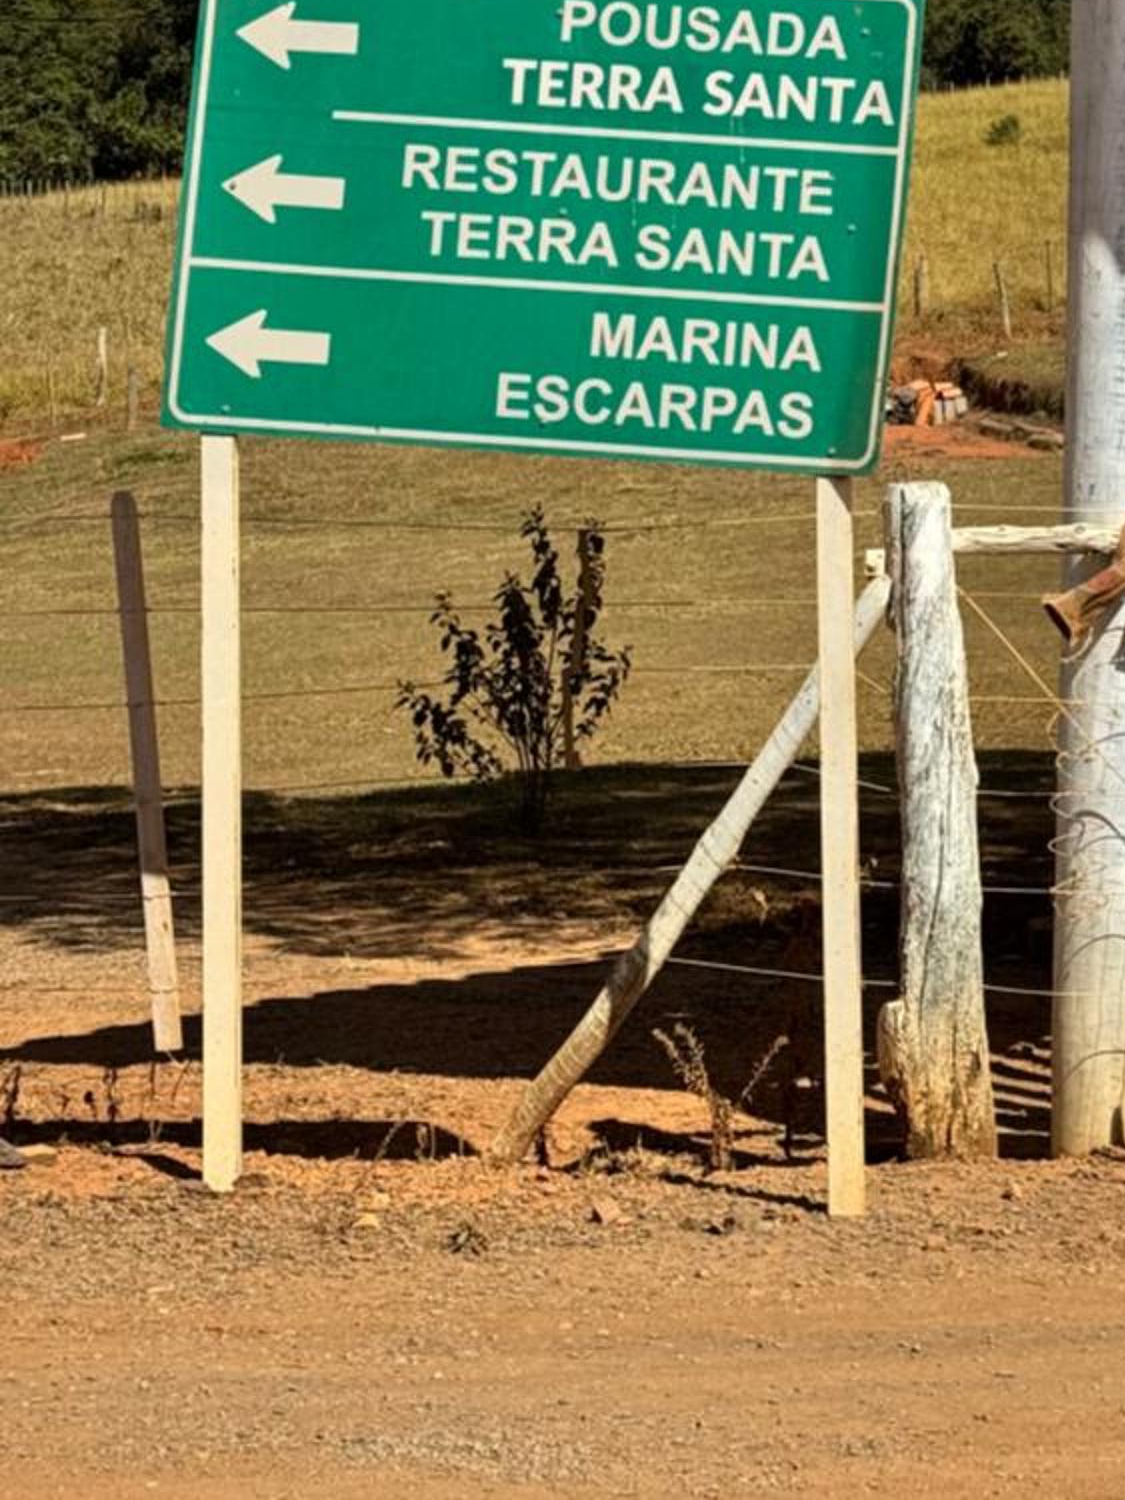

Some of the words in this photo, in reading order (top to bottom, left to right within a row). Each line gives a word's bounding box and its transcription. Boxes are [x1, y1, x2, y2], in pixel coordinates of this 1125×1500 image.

[561, 0, 846, 59] POUSADA
[503, 59, 682, 112] TERRA
[703, 71, 893, 125] SANTA
[403, 144, 833, 214] RESTAURANTE
[422, 211, 618, 266] TERRA
[636, 225, 828, 281] SANTA
[591, 313, 820, 371] MARINA
[497, 373, 812, 438] ESCARPAS
